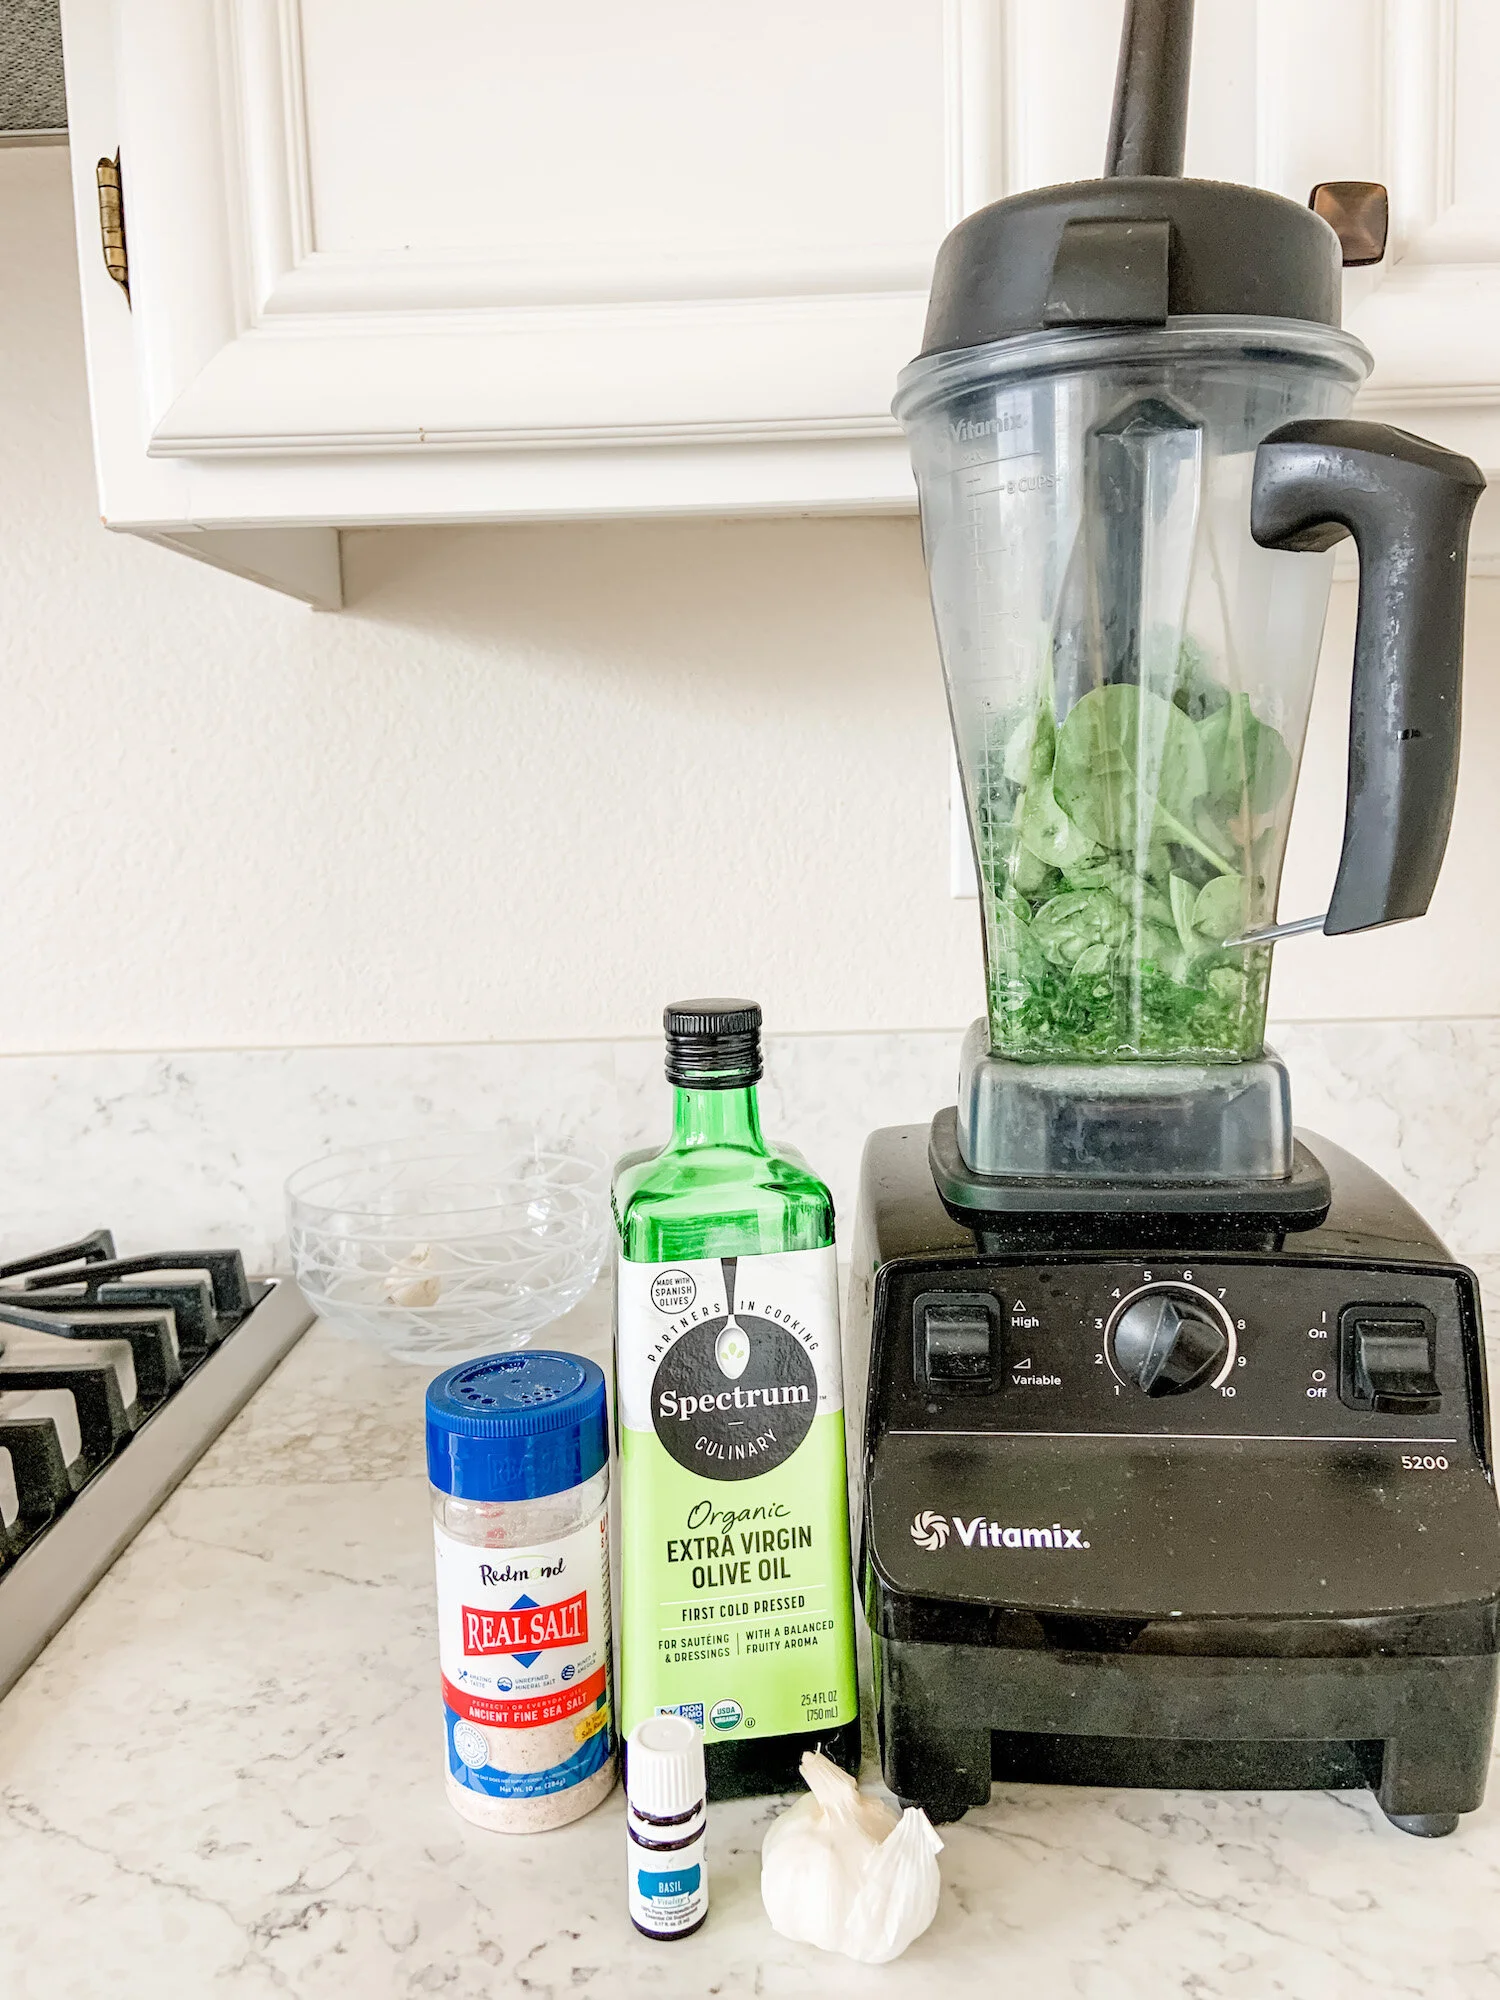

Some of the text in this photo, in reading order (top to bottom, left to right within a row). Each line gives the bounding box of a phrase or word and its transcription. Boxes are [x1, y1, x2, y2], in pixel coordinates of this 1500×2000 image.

[950, 412, 1024, 442] Vitamix
[1143, 1271, 1152, 1281] 5
[1183, 1271, 1192, 1281] 6
[655, 1286, 692, 1297] SPANISH
[1111, 1288, 1121, 1298] 4
[1218, 1288, 1227, 1298] 7
[659, 1296, 689, 1307] OLIVES
[1011, 1316, 1040, 1328] High
[1094, 1318, 1103, 1329] 3
[1237, 1319, 1246, 1330] 8
[647, 1300, 819, 1362] PARTNERS IN COOKING
[1308, 1328, 1327, 1339] On
[1094, 1354, 1103, 1364] 2
[1238, 1356, 1247, 1367] 9
[1012, 1374, 1062, 1385] Variable
[1114, 1385, 1120, 1395] 1
[1220, 1387, 1236, 1397] 10
[1306, 1387, 1328, 1398] Off
[659, 1384, 811, 1421] Spectrum
[694, 1428, 777, 1460] CULINARY
[1401, 1456, 1449, 1470] 5200
[687, 1500, 791, 1535] Organic
[951, 1516, 1084, 1549] Vitamix
[667, 1525, 812, 1563] EXTRA VIRGIN
[479, 1557, 567, 1586] Redmond
[692, 1557, 791, 1589] OLIVE OIL
[682, 1595, 805, 1622] FIRST COLD PRESSED
[465, 1599, 583, 1652] REAL SALT
[746, 1619, 834, 1640] WITH A BALANCED
[658, 1633, 730, 1650] FOR SAUTÉING
[746, 1636, 818, 1654] FRUITY AROMA
[665, 1647, 730, 1663] & DRESSINGS
[515, 1674, 549, 1684] UNREFINED
[515, 1679, 556, 1690] MINERAL SALT
[801, 1690, 837, 1706] 25.4 FL OZ
[468, 1692, 588, 1723] ANCIENT FINE SEA SALT
[682, 1704, 702, 1713] NON
[716, 1706, 736, 1715] USDA
[658, 1880, 682, 1894] BASIL
